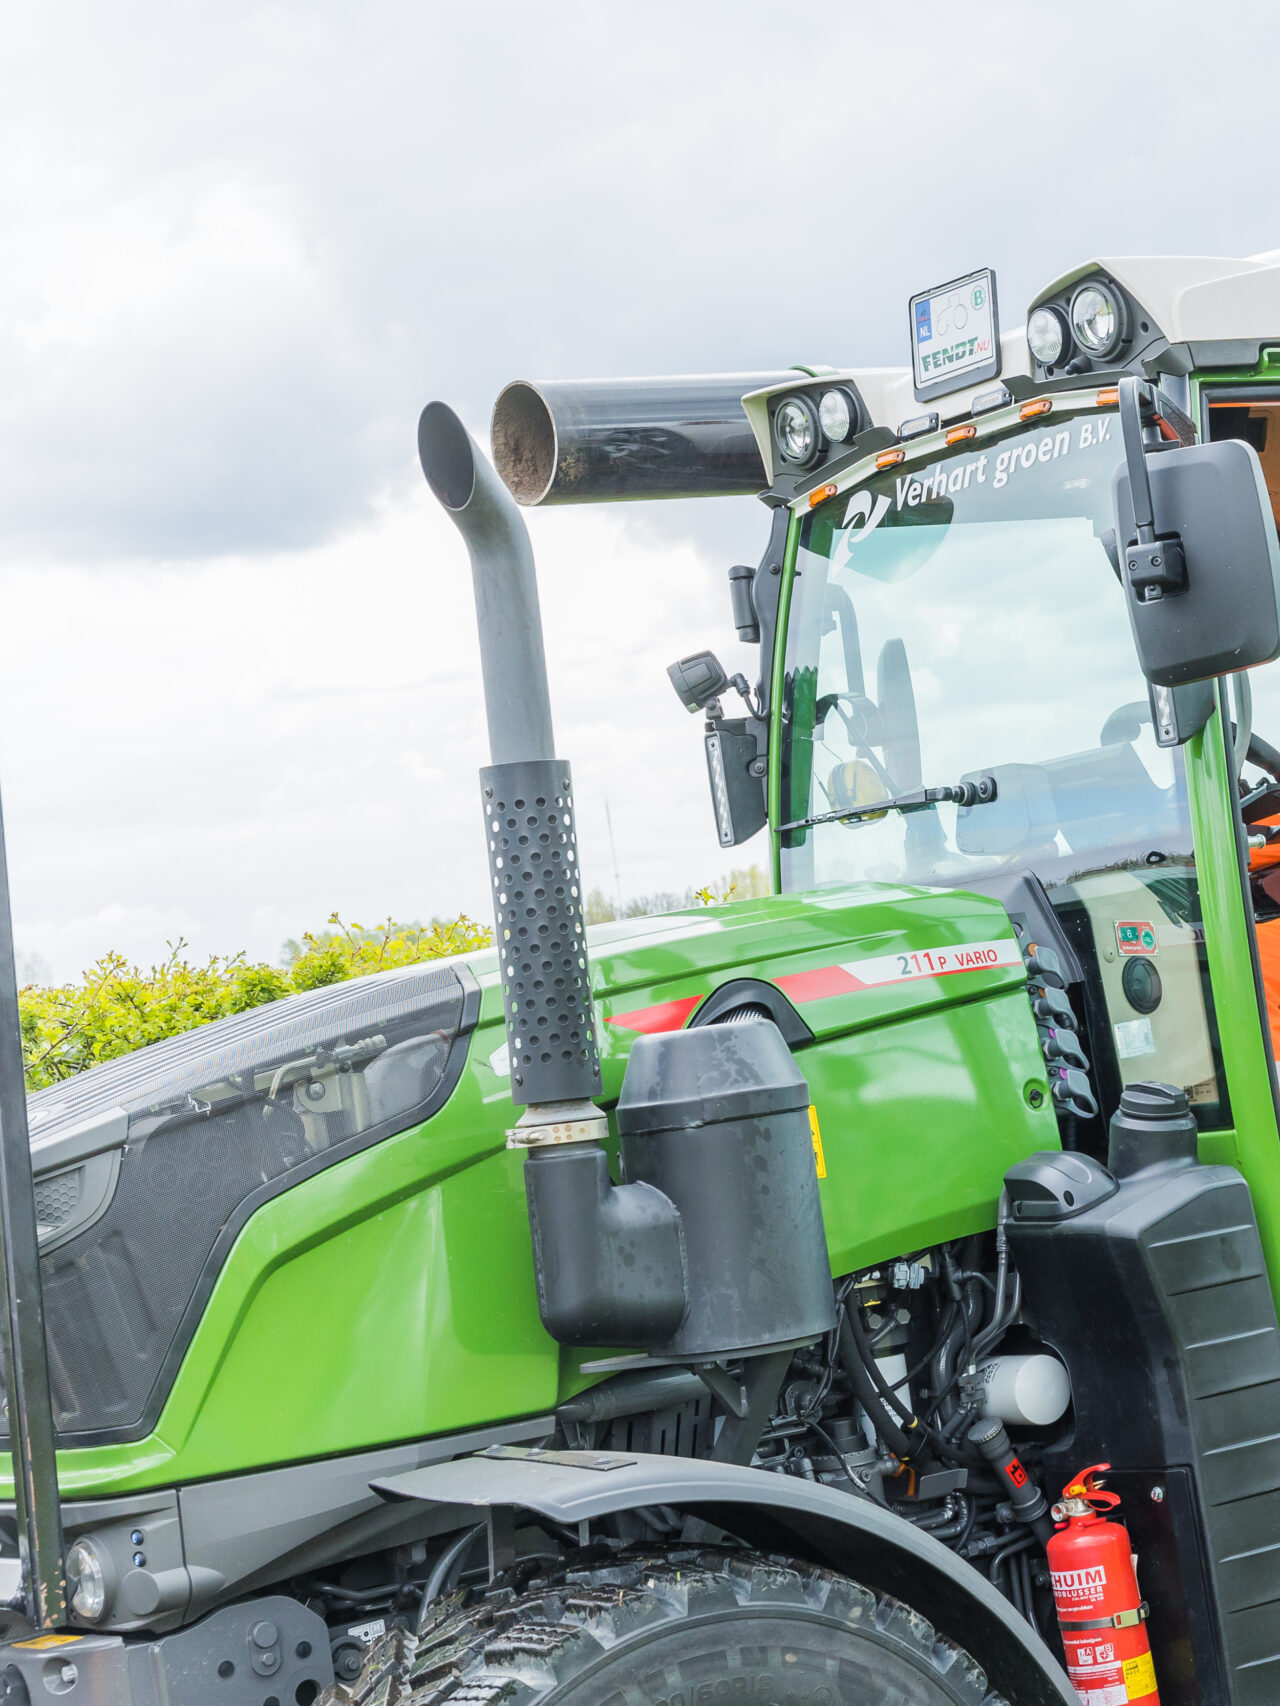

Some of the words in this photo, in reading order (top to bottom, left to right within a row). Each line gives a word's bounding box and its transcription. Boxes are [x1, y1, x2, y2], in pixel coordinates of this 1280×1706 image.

[973, 289, 984, 307] B
[919, 325, 931, 339] NL
[895, 457, 987, 511] Verhart
[993, 431, 1070, 489] groen
[1079, 417, 1112, 450] B.V.
[896, 952, 936, 976] 211
[954, 949, 998, 967] VARIO
